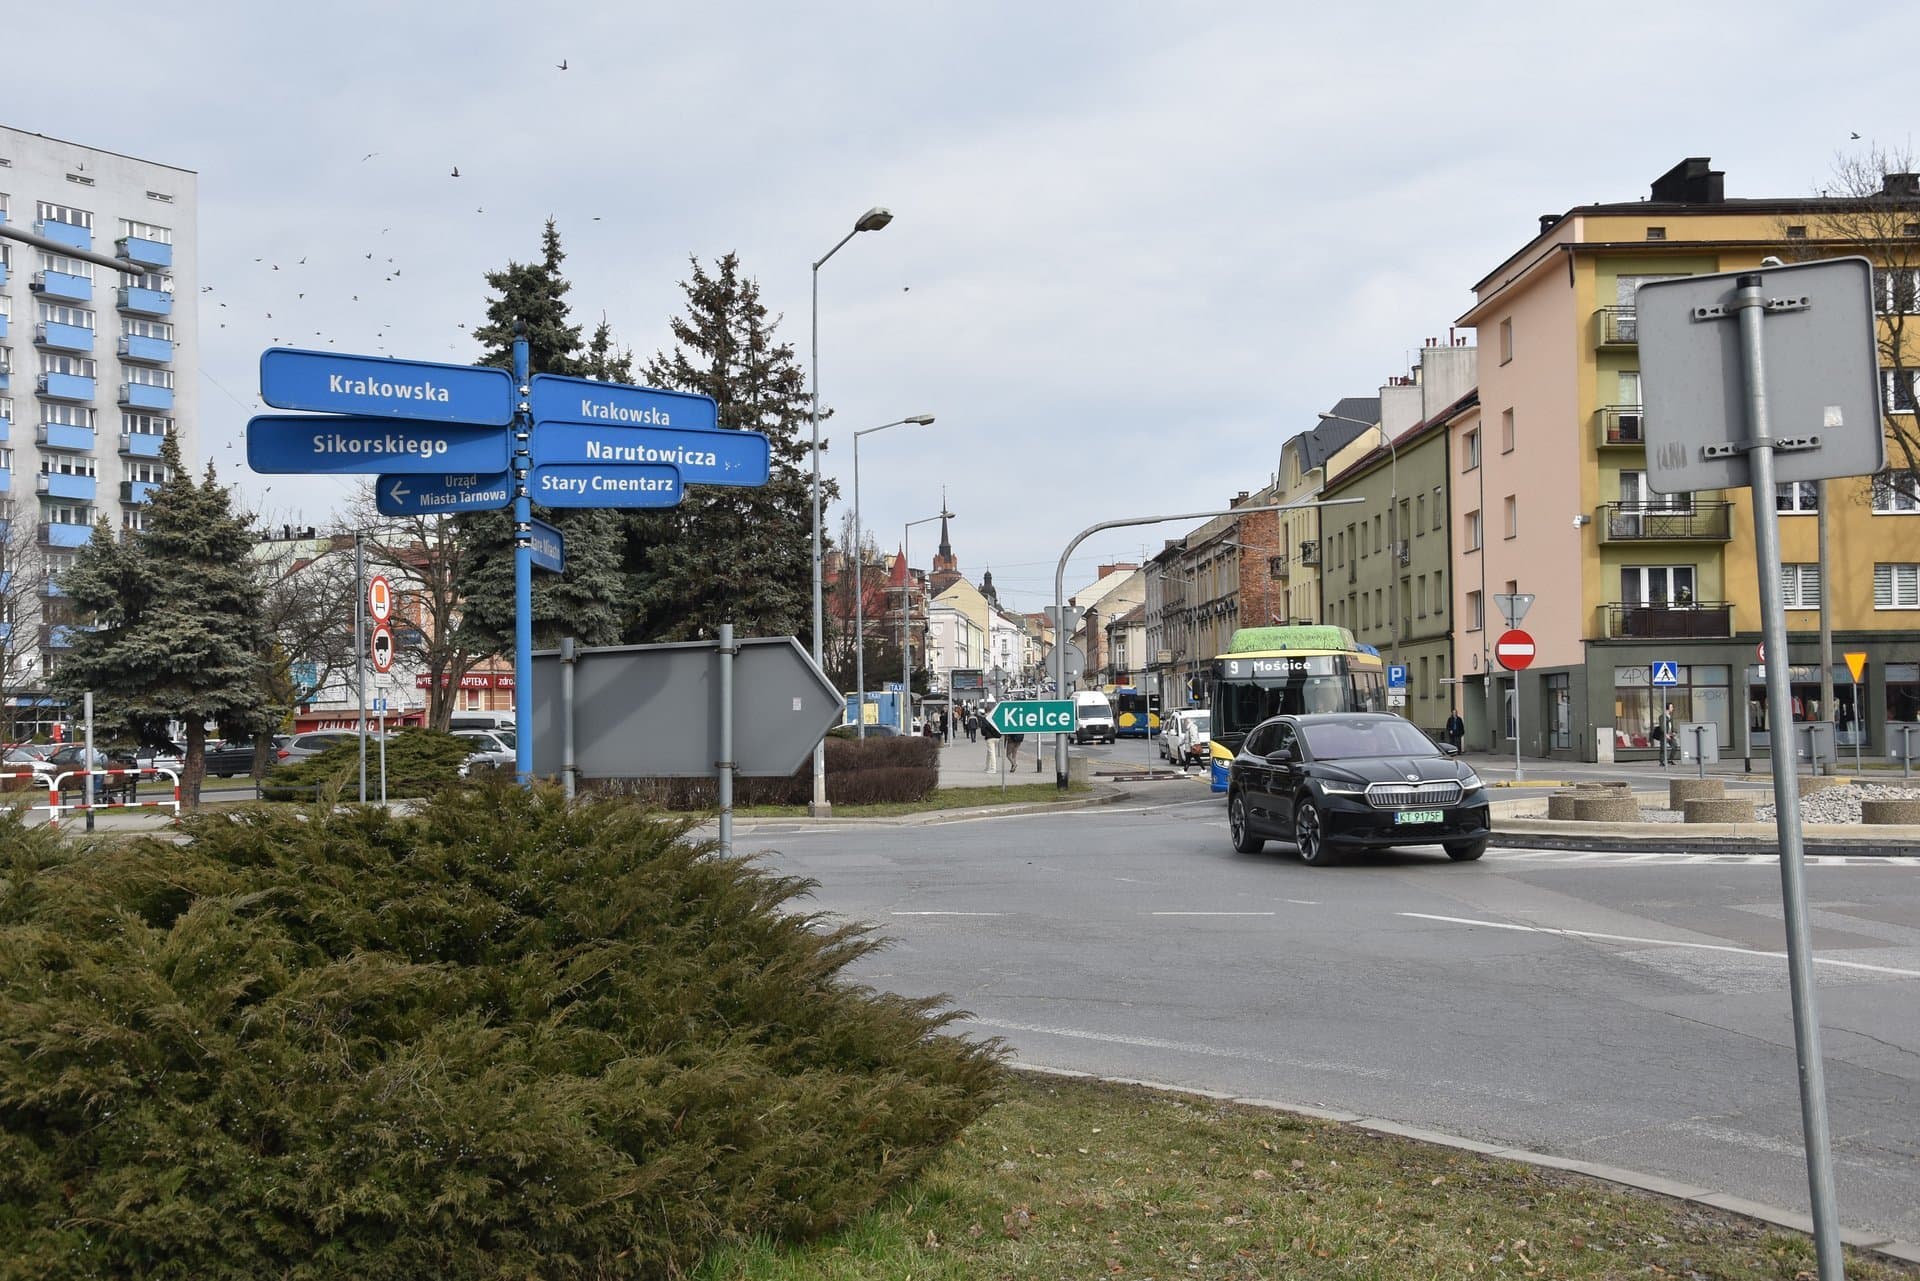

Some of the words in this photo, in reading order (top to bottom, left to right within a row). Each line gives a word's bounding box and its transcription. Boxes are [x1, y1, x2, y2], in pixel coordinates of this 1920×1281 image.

[329, 374, 449, 402] Krakowska
[581, 399, 670, 426] Krakowska
[313, 434, 448, 458] Sikorskiego
[586, 441, 716, 466] Narutowicza
[445, 474, 477, 489] Urząd
[541, 475, 587, 494] Stary
[591, 475, 673, 491] Cmentarz
[420, 493, 457, 506] Miasta
[459, 490, 506, 503] Tarnowa
[1230, 661, 1239, 675] 9
[1253, 659, 1313, 672] Mościce
[1391, 667, 1402, 682] P
[461, 677, 489, 686] APTEKA
[1004, 707, 1071, 727] Kielce
[1400, 812, 1411, 822] KT
[1414, 811, 1441, 821] 9175F
